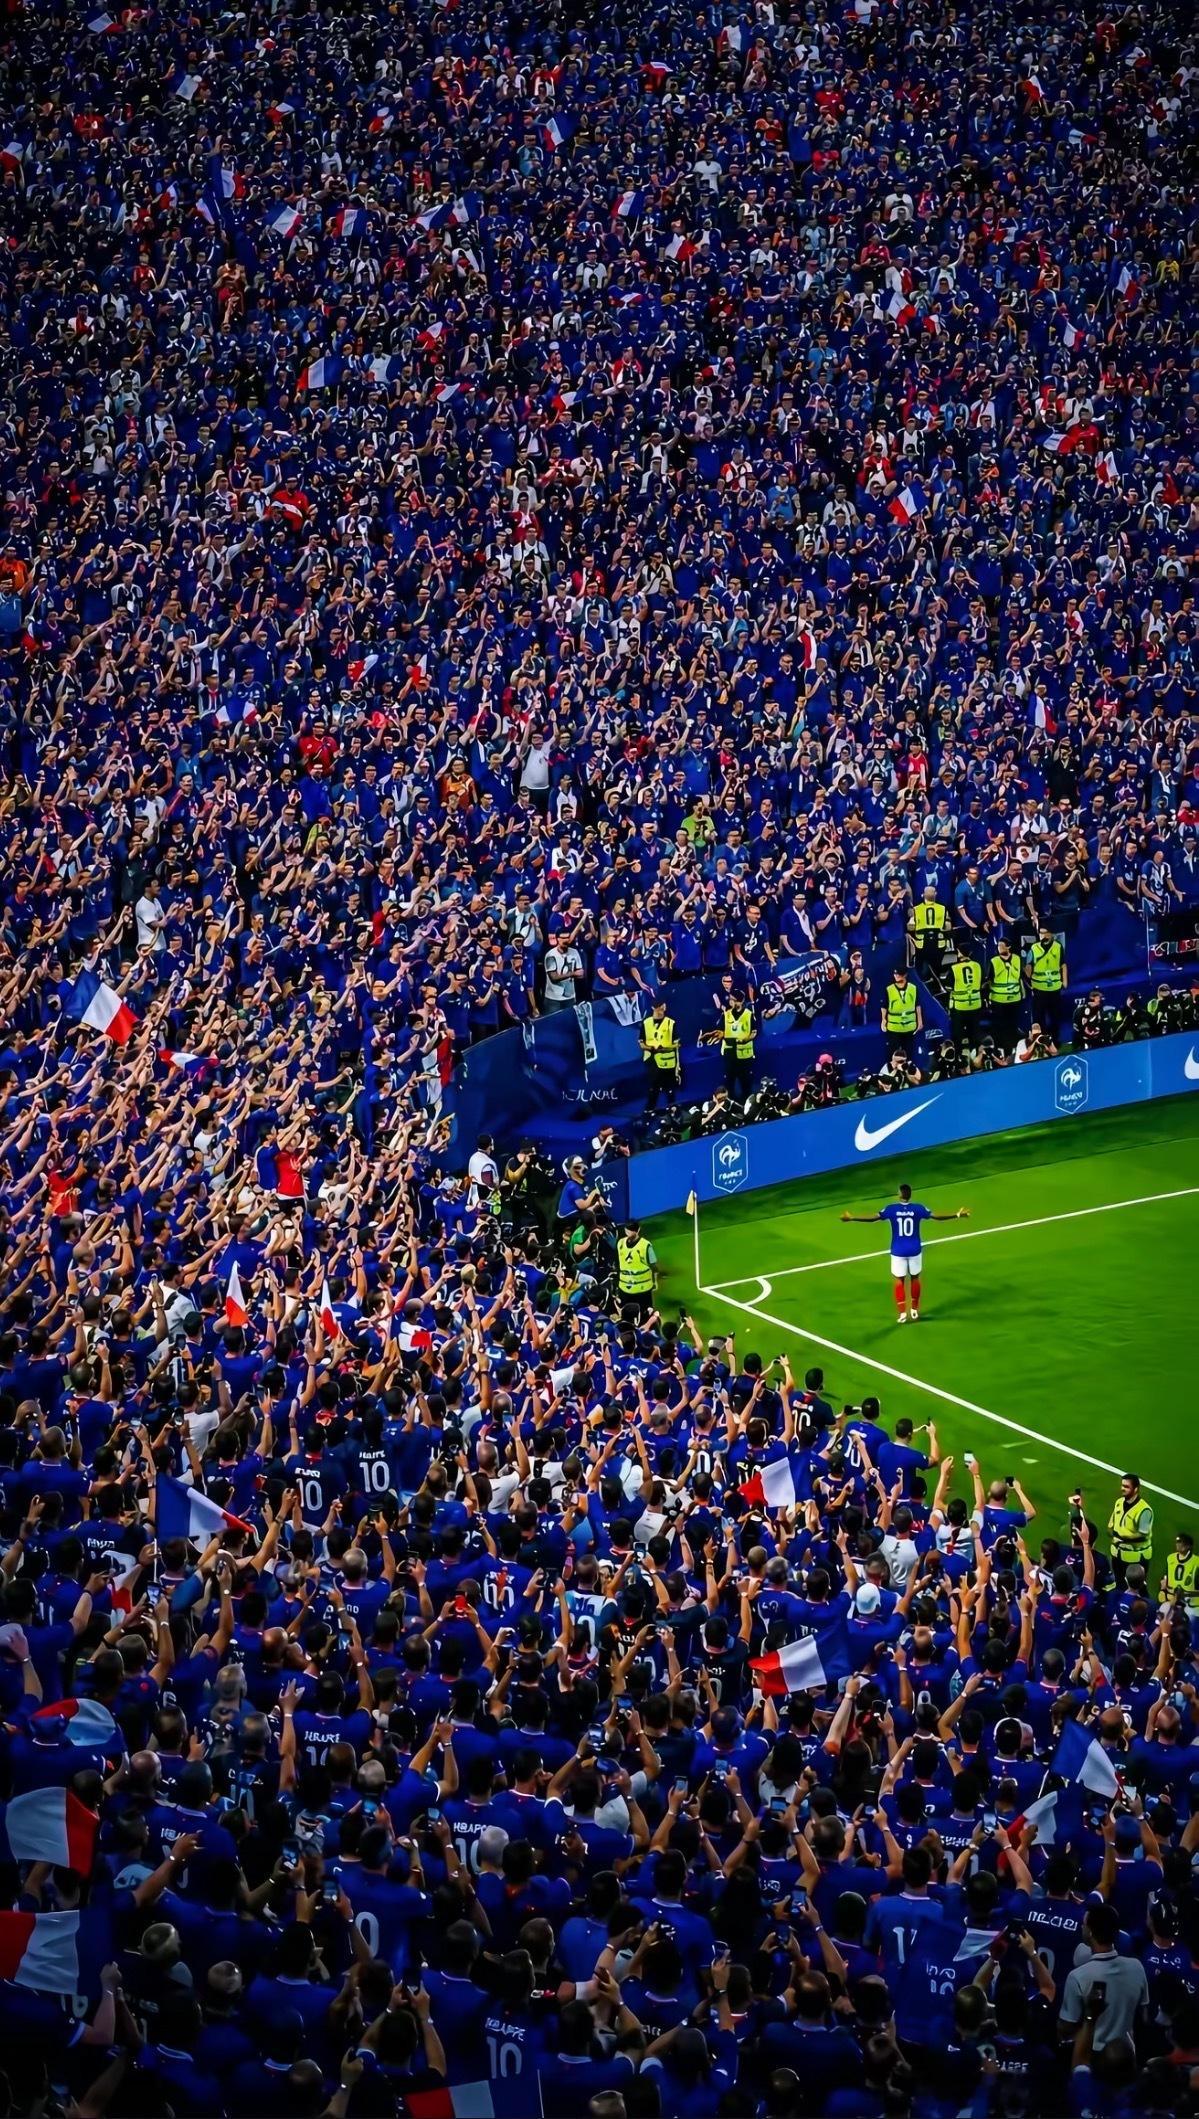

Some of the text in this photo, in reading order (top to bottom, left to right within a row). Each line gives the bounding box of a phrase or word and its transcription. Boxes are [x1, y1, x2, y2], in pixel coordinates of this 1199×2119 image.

[896, 1217, 914, 1237] 10
[359, 1460, 390, 1493] 10
[296, 1478, 323, 1511] 10
[486, 2035, 523, 2080] 10
